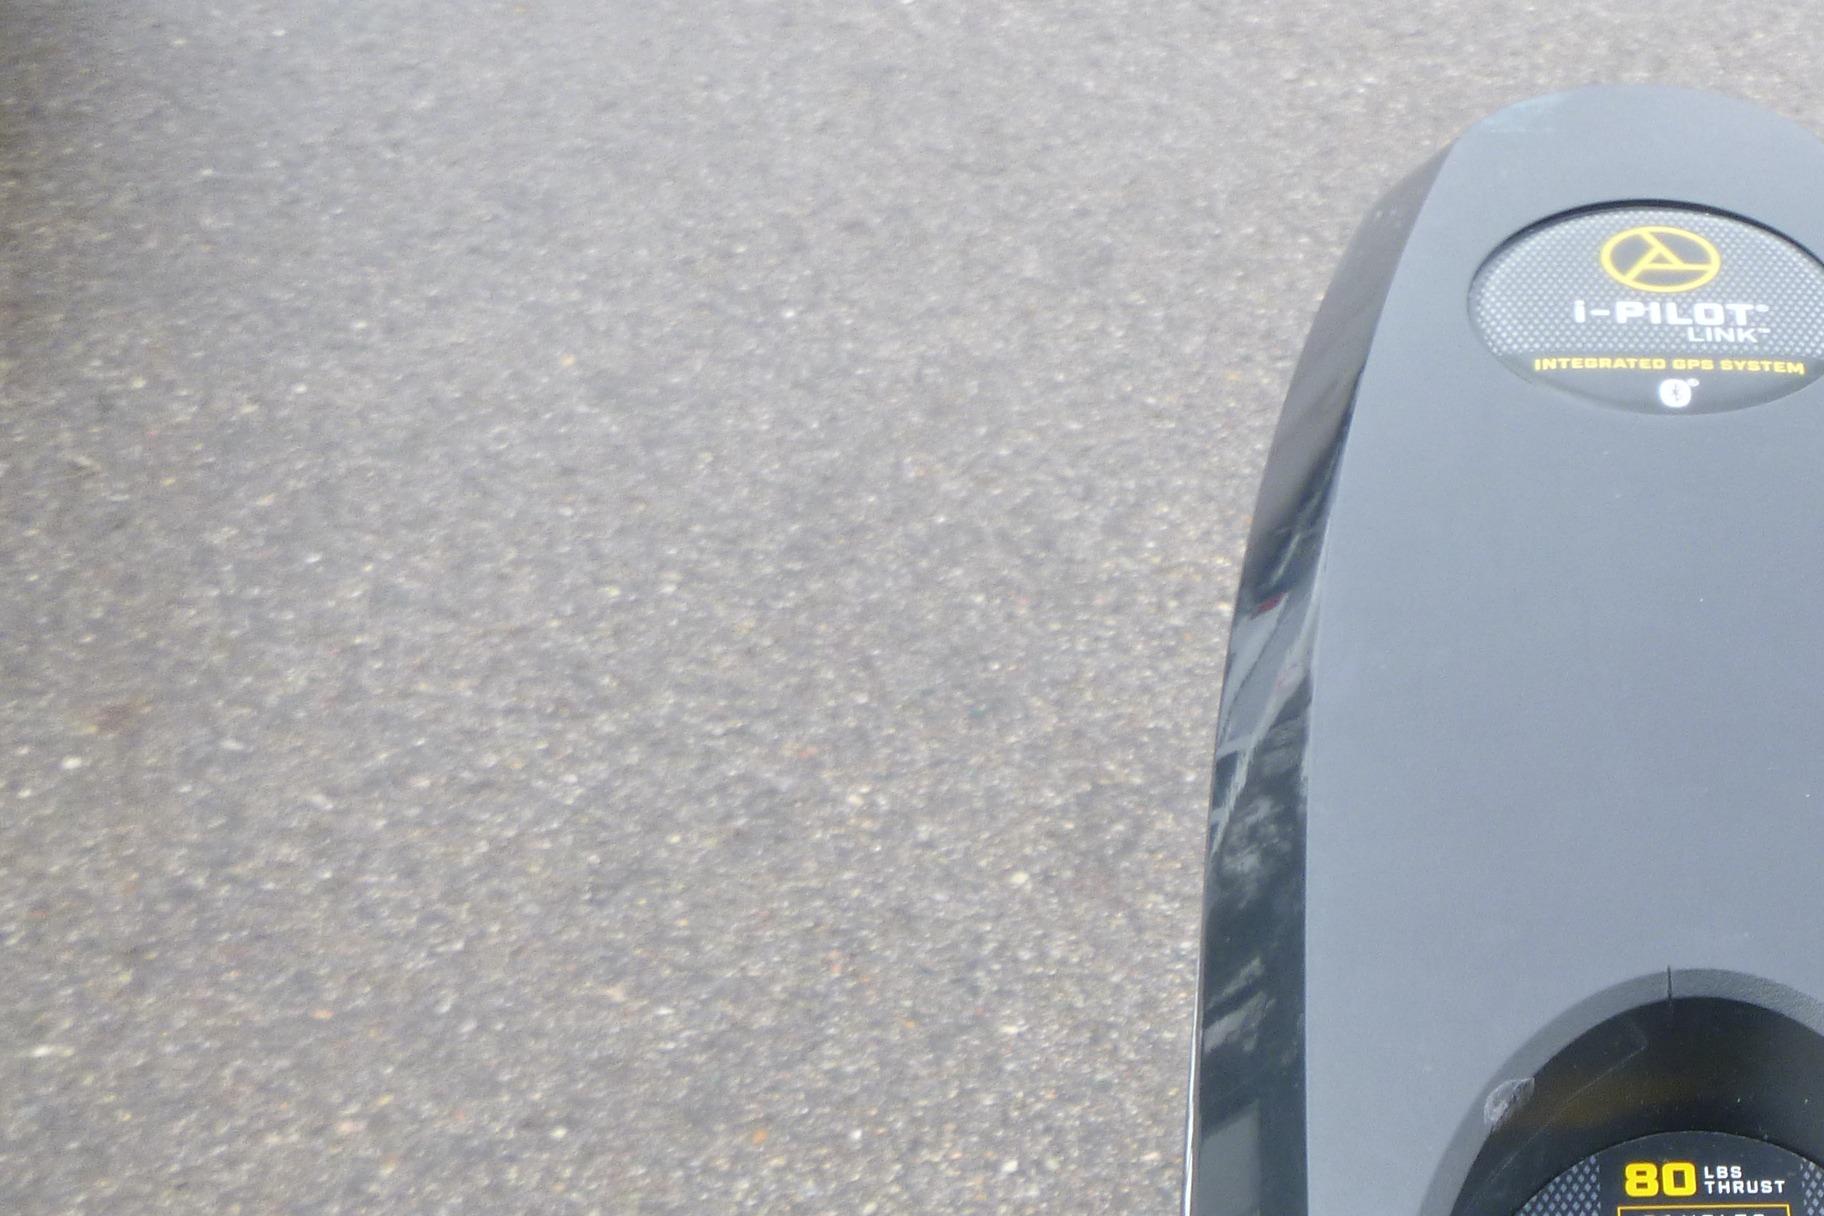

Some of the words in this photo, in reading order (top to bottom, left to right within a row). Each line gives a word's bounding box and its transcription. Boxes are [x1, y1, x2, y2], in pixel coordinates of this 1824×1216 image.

[1534, 358, 1666, 371] INTEGRATED
[1672, 359, 1714, 371] GPS
[1720, 360, 1805, 375] SYSTEM
[1625, 1162, 1697, 1197] 80
[1704, 1166, 1742, 1179] LBS
[1704, 1180, 1785, 1194] THRUST
